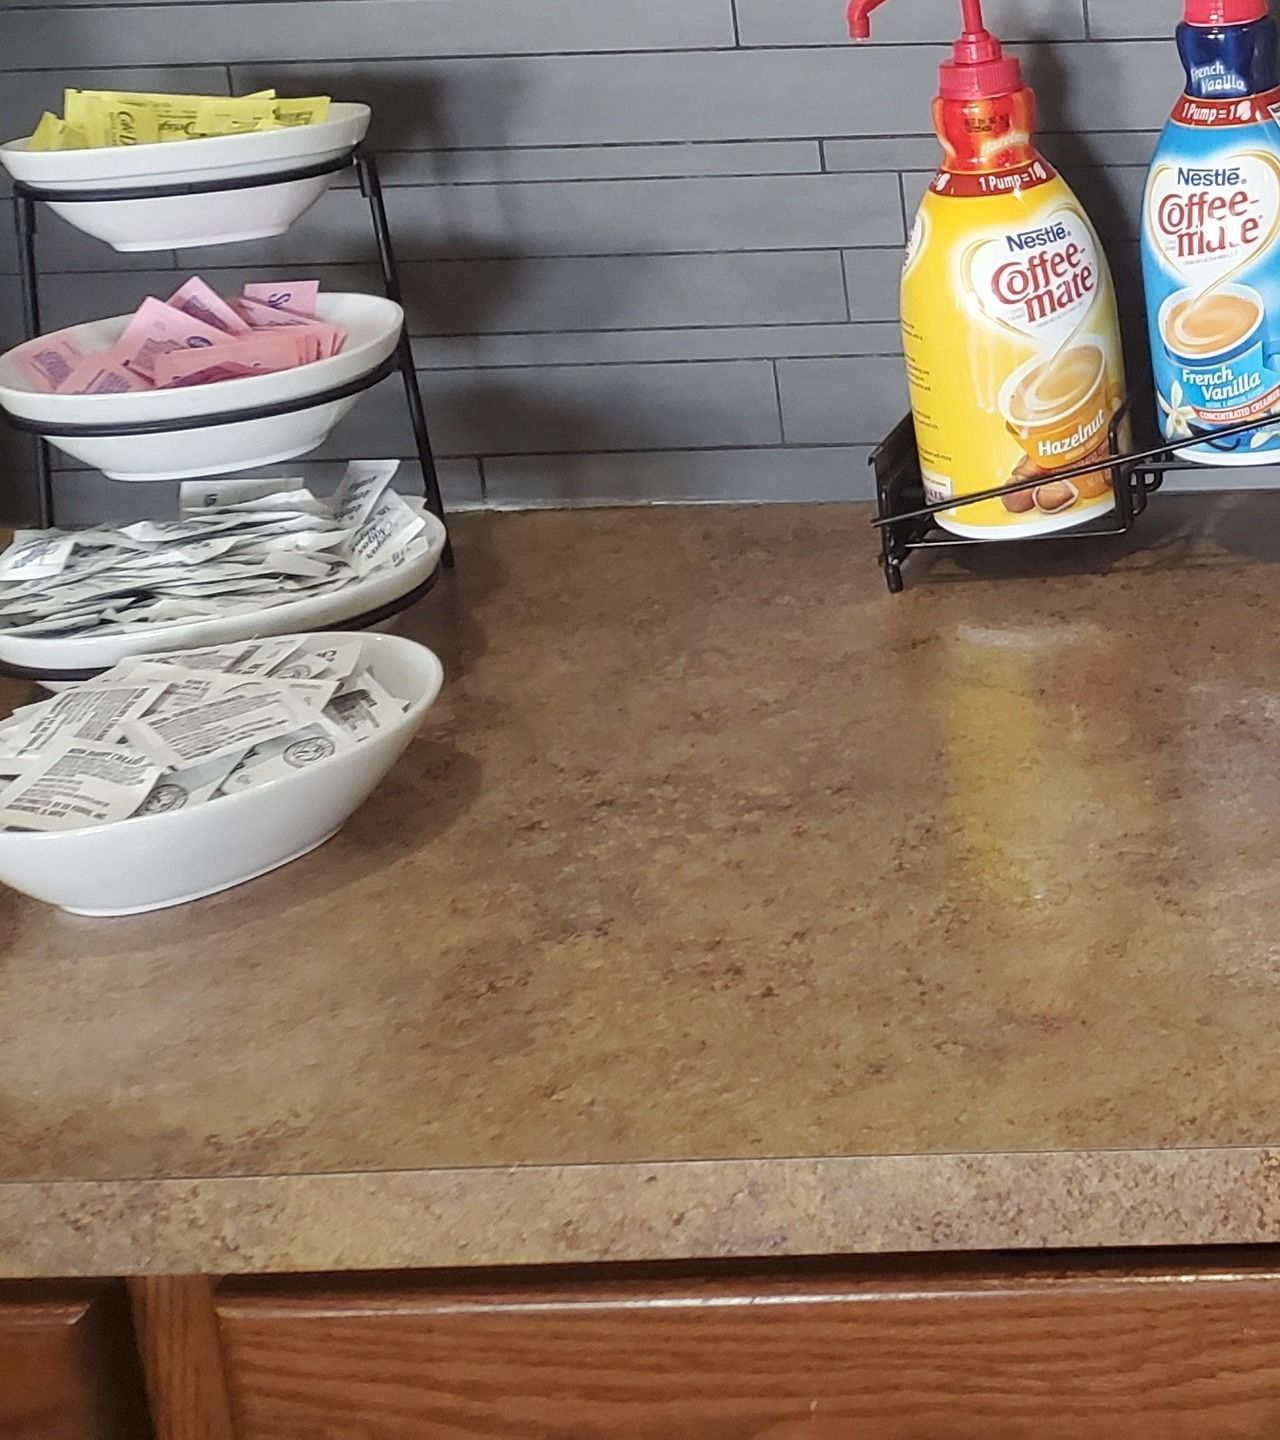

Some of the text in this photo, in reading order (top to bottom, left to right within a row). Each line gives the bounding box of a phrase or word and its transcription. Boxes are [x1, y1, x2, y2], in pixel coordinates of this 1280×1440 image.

[1187, 104, 1216, 123] Pump
[989, 174, 1022, 191] Pump
[1177, 216, 1259, 258] mae
[1025, 266, 1096, 324] mate
[1182, 365, 1234, 386] French
[1201, 371, 1261, 401] Vanilla
[1038, 409, 1105, 457] Hazelnut
